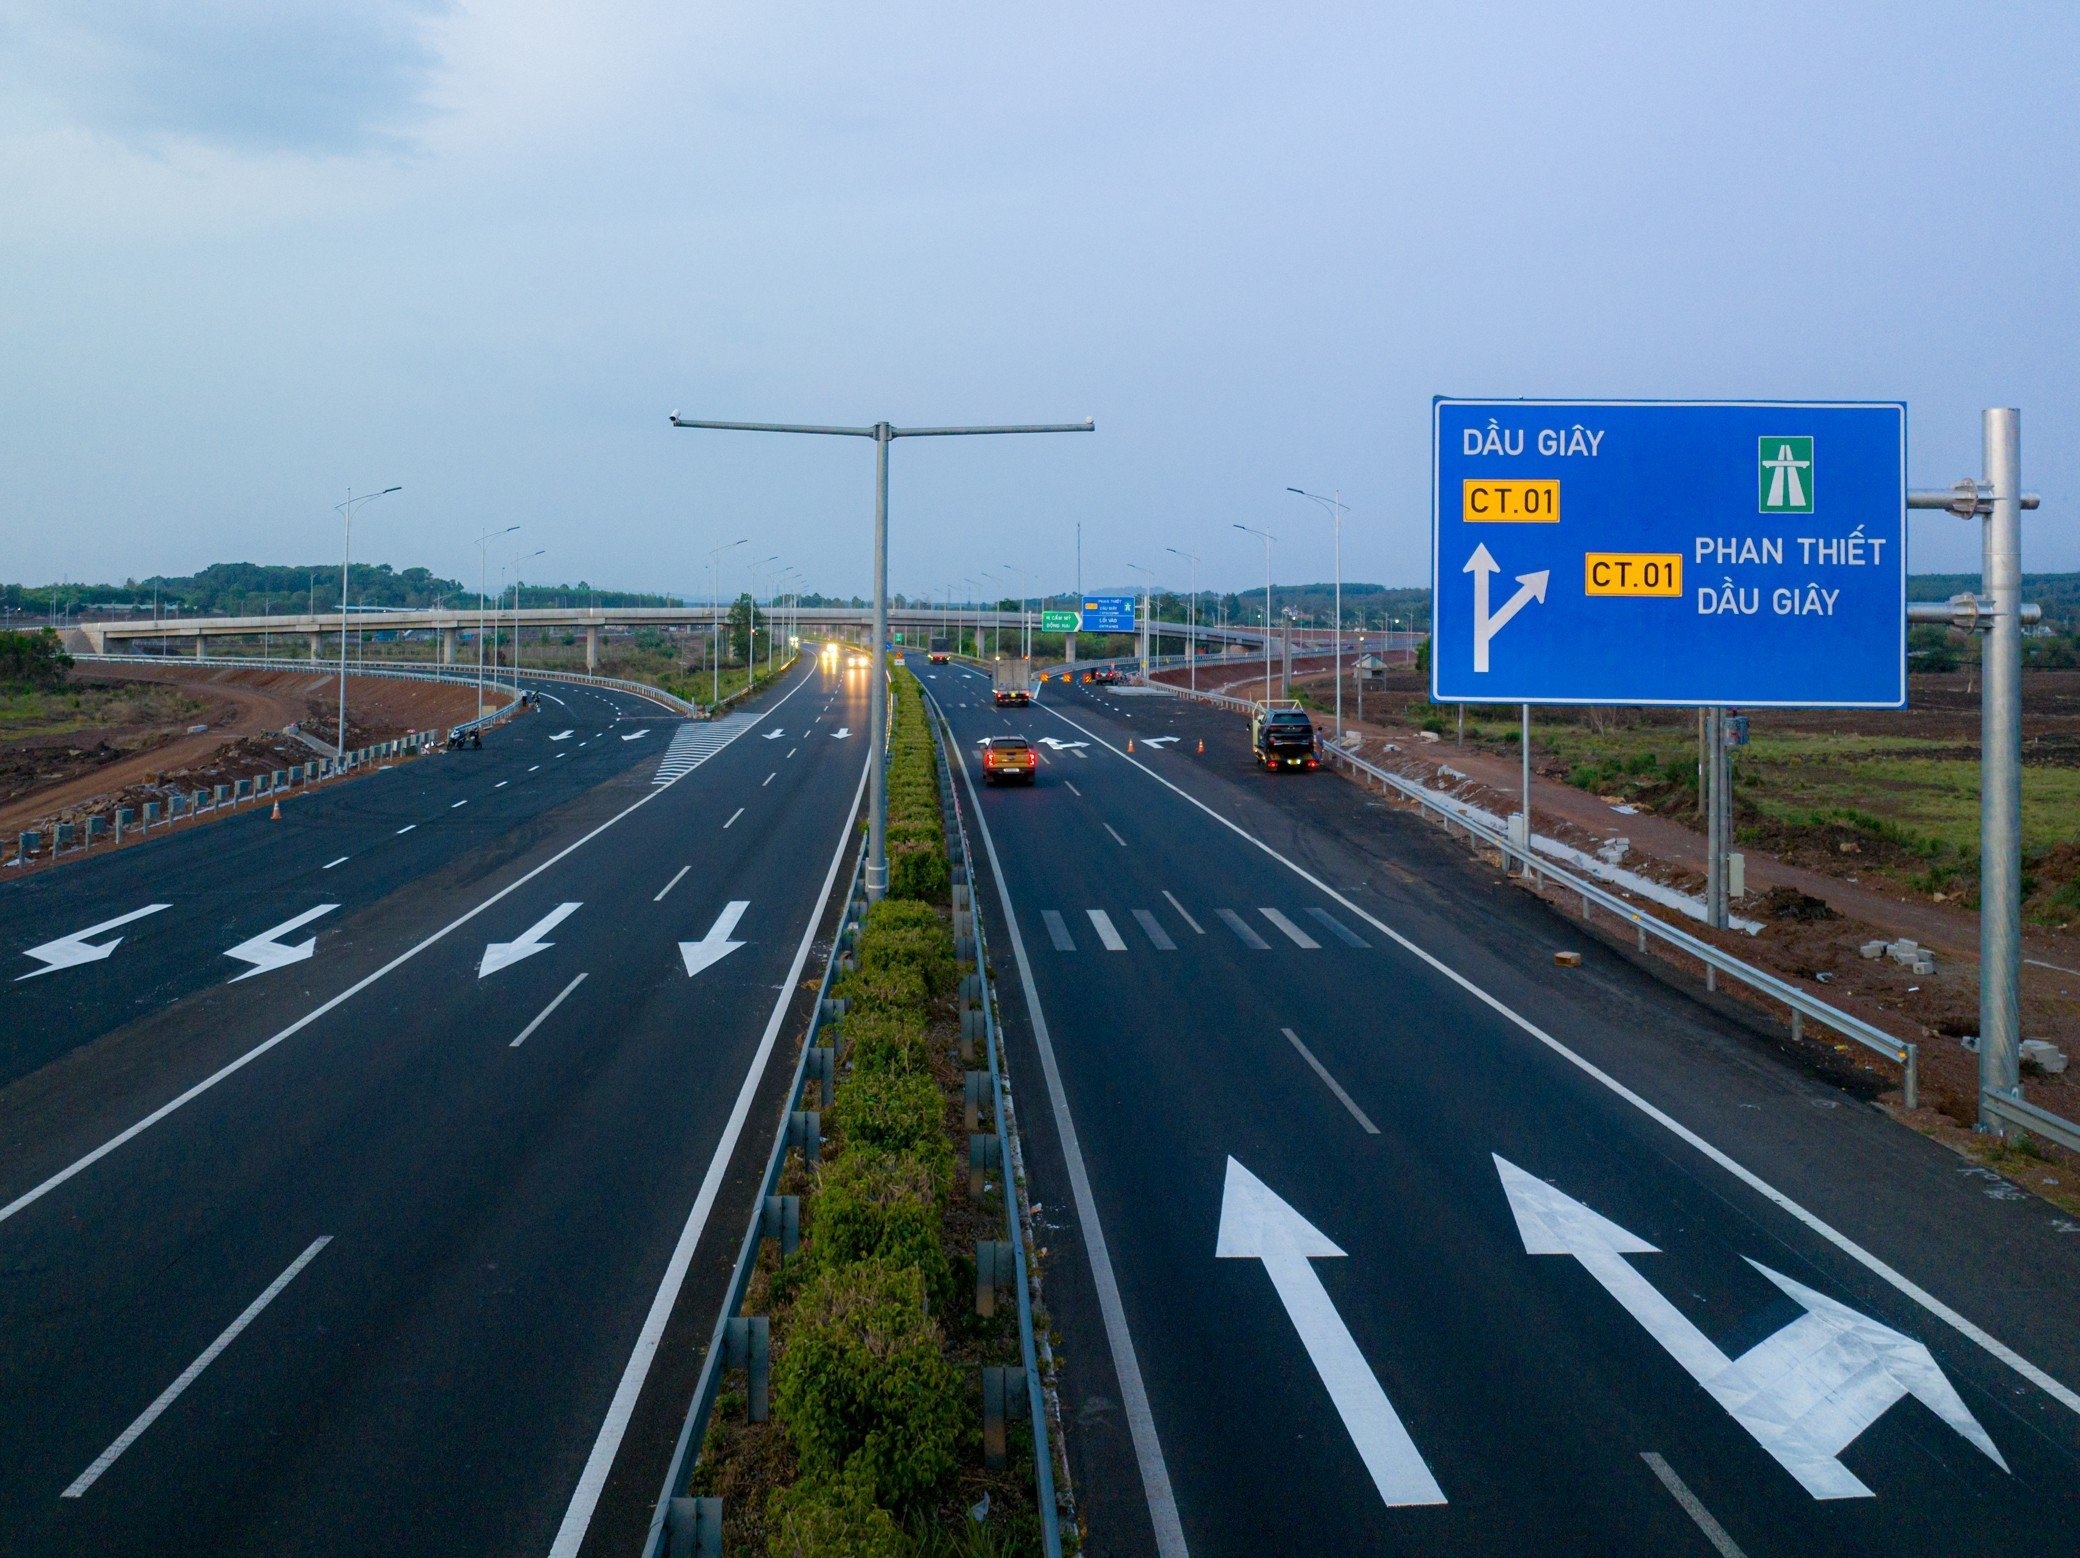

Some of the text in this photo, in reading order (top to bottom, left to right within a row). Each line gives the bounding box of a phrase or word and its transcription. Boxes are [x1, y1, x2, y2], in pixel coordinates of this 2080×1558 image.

[1463, 418, 1605, 457] DẦU GIÂY
[1470, 488, 1552, 514] CT.01
[1695, 524, 1886, 565] PHAN THIẾT
[1592, 561, 1672, 588] CT.01
[1699, 576, 1840, 616] DẦU GIÂY
